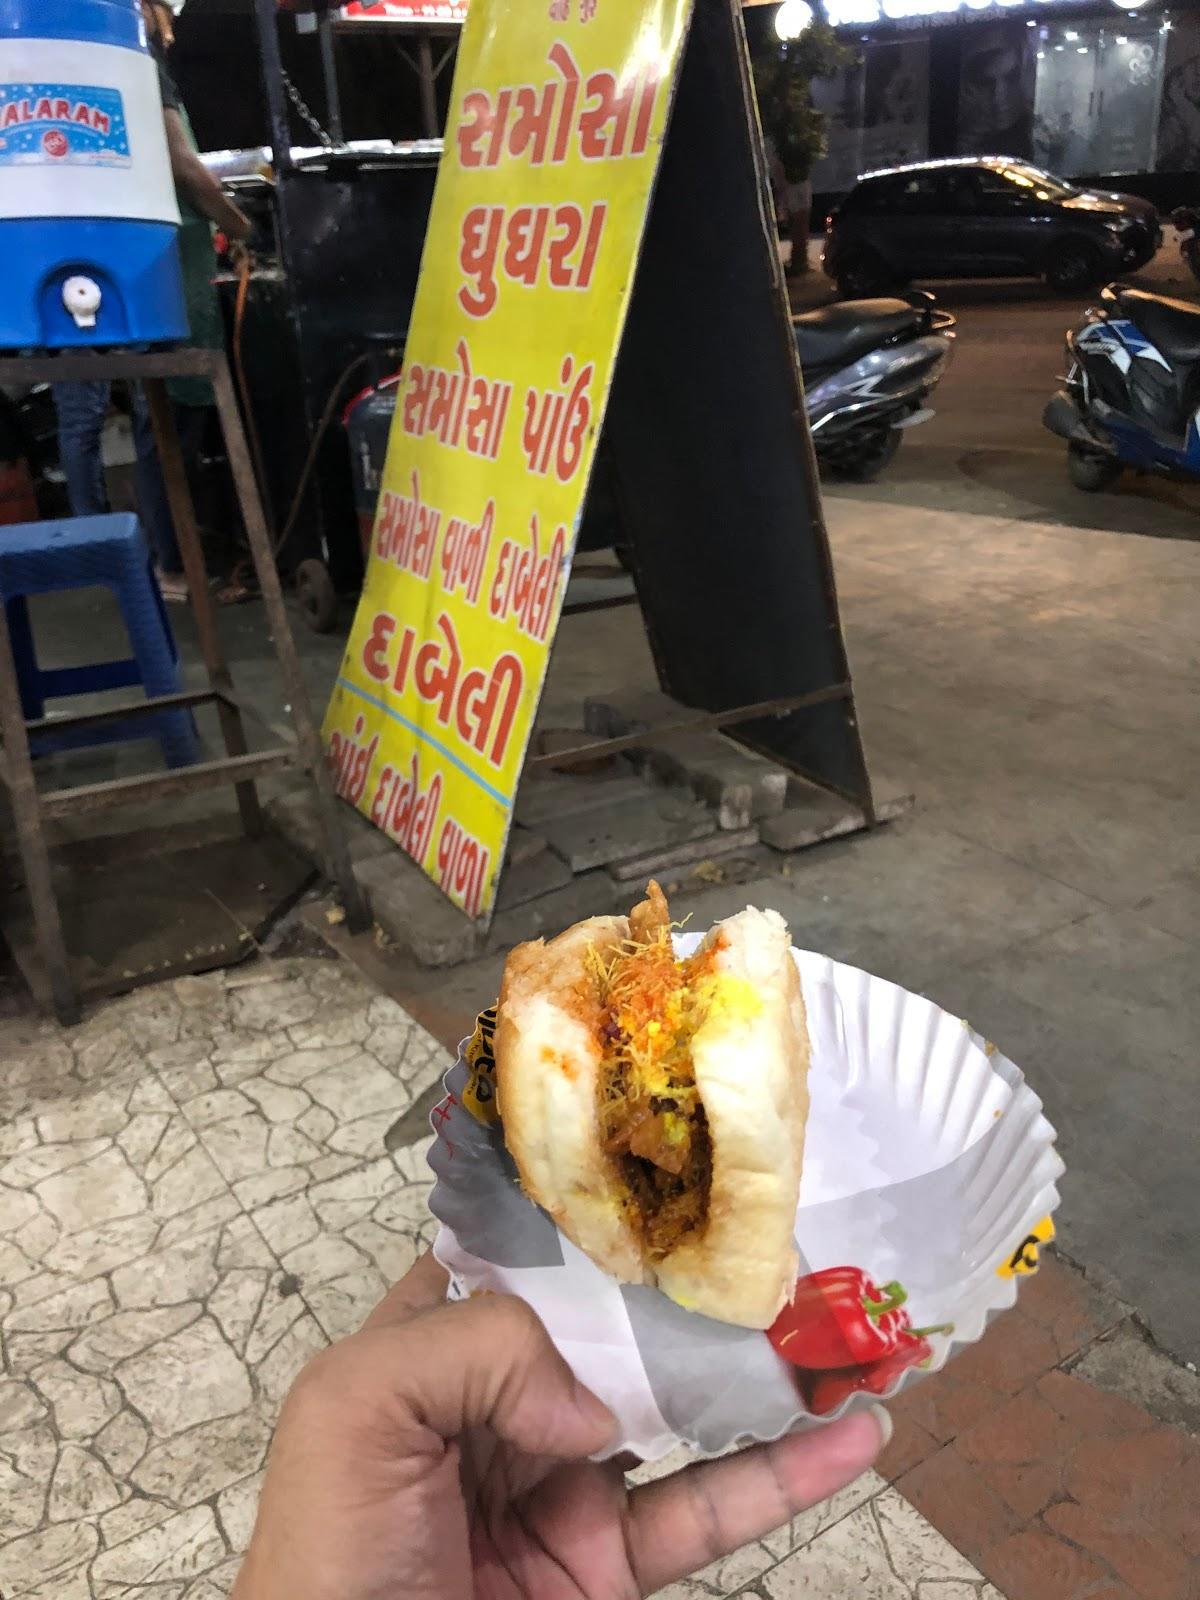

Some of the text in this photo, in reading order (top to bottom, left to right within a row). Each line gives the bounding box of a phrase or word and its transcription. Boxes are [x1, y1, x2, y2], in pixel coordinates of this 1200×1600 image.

[2, 98, 112, 136] ALARAM
[457, 42, 658, 168] સમોસા
[458, 203, 607, 317] ઘુઘરા
[403, 340, 593, 482] સમોસા પાંઉ
[376, 470, 566, 642] સમોસા વાળી દાબેલી
[362, 613, 523, 767] દાબેલી
[370, 753, 442, 865] દાબેલી
[438, 819, 488, 919] વાળા
